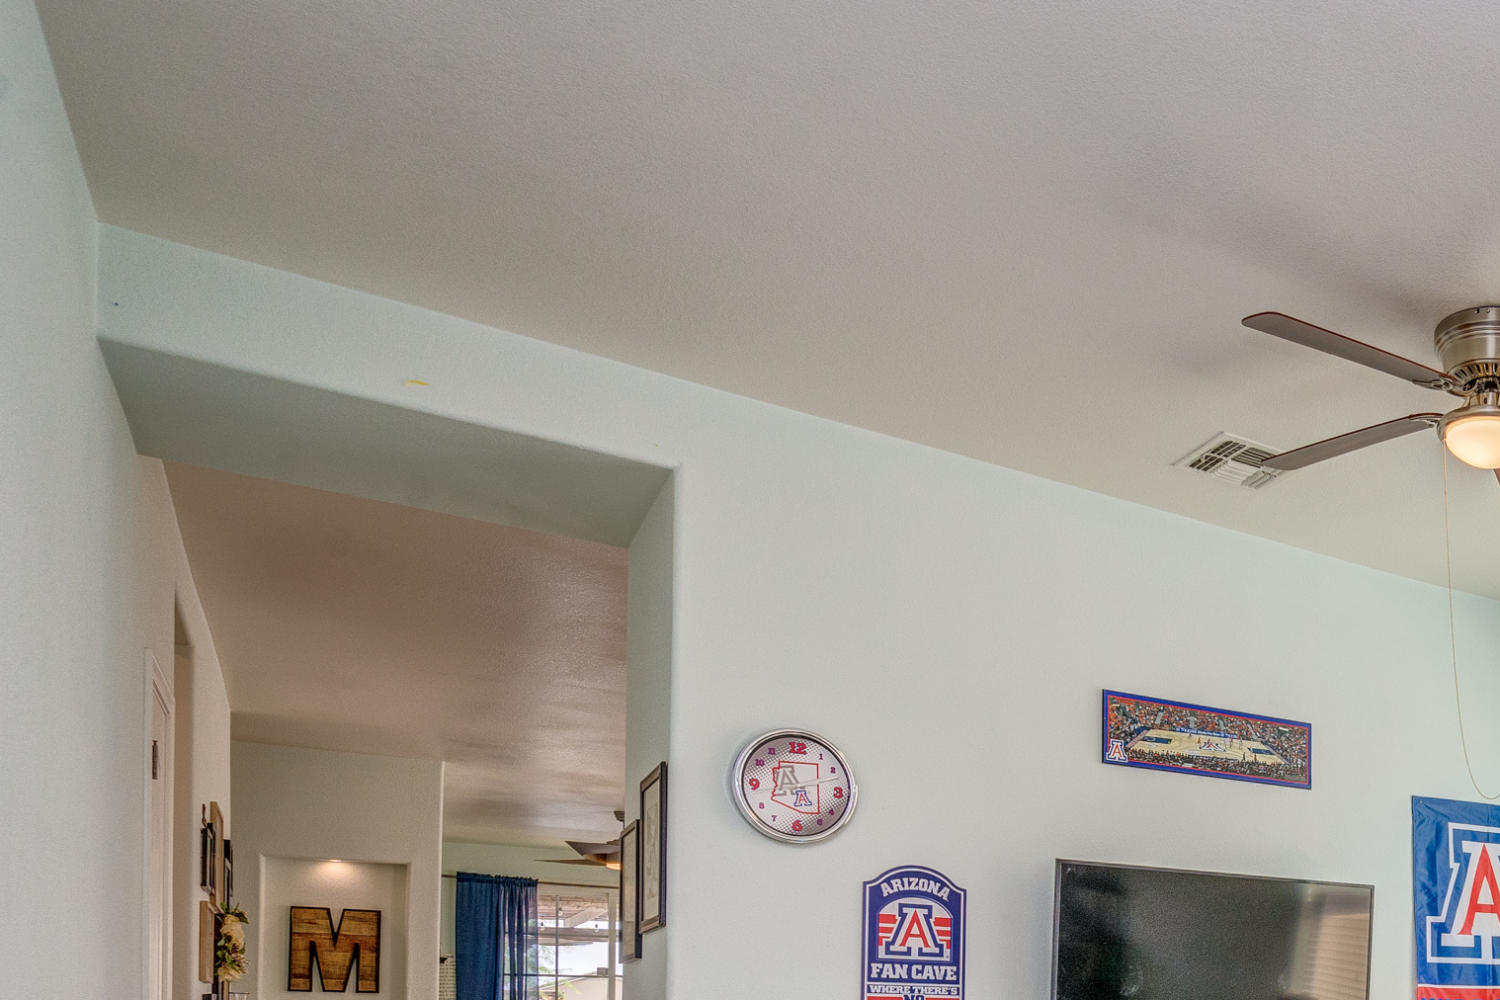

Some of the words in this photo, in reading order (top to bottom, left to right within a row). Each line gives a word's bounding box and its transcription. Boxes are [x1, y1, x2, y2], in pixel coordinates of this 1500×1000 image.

[789, 742, 807, 755] 12
[1106, 739, 1128, 762] A
[749, 778, 760, 791] 9
[794, 790, 812, 806] A
[833, 787, 843, 799] 3
[792, 820, 803, 832] 6
[880, 877, 950, 901] ARIZONA
[884, 902, 945, 958] A
[287, 905, 381, 993] M
[870, 963, 908, 979] FAN
[911, 965, 957, 981] CAVE
[869, 984, 911, 994] WHERE
[912, 986, 958, 995] THERE'S
